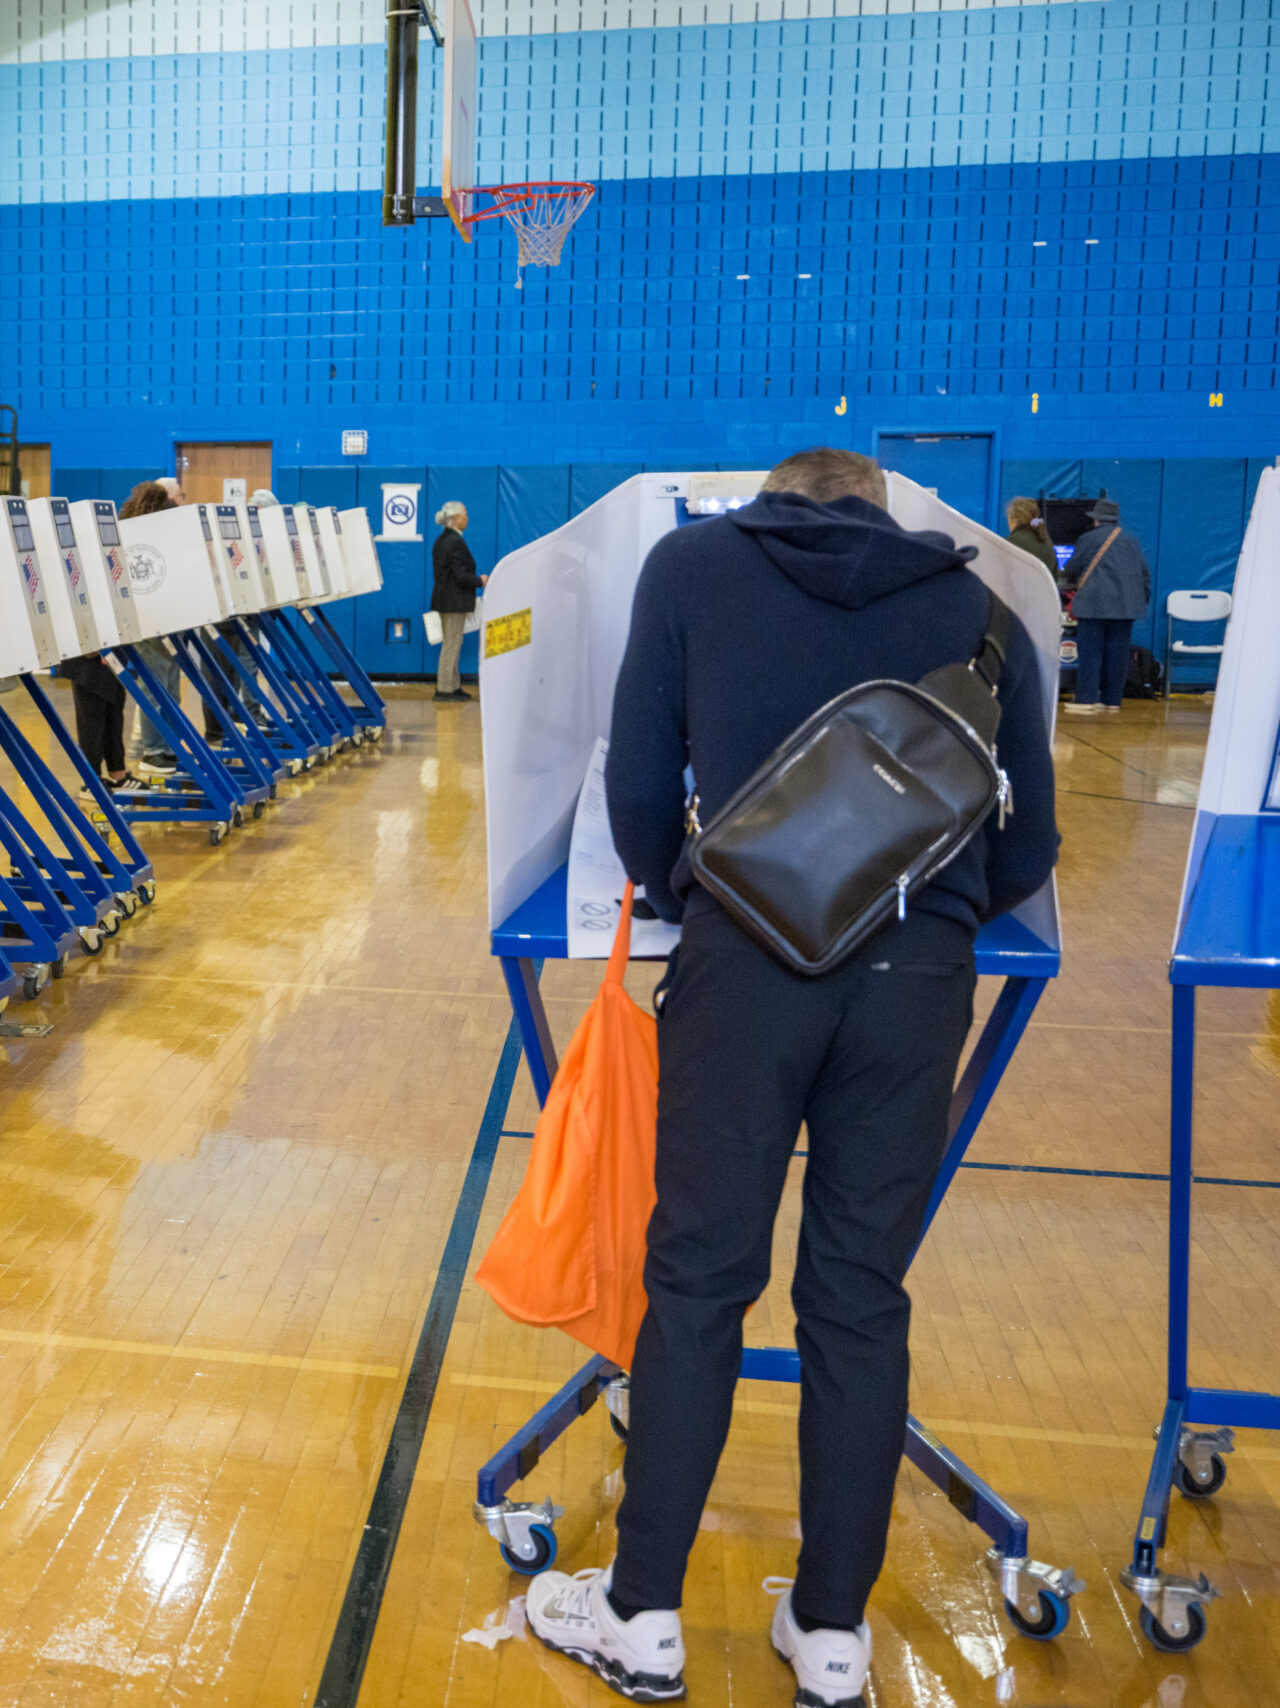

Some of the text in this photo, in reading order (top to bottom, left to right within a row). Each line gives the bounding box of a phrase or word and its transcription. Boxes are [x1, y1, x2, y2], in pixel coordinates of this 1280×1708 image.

[1209, 392, 1224, 407] H
[657, 1636, 677, 1650] NIKE
[825, 1661, 851, 1674] NIKE
